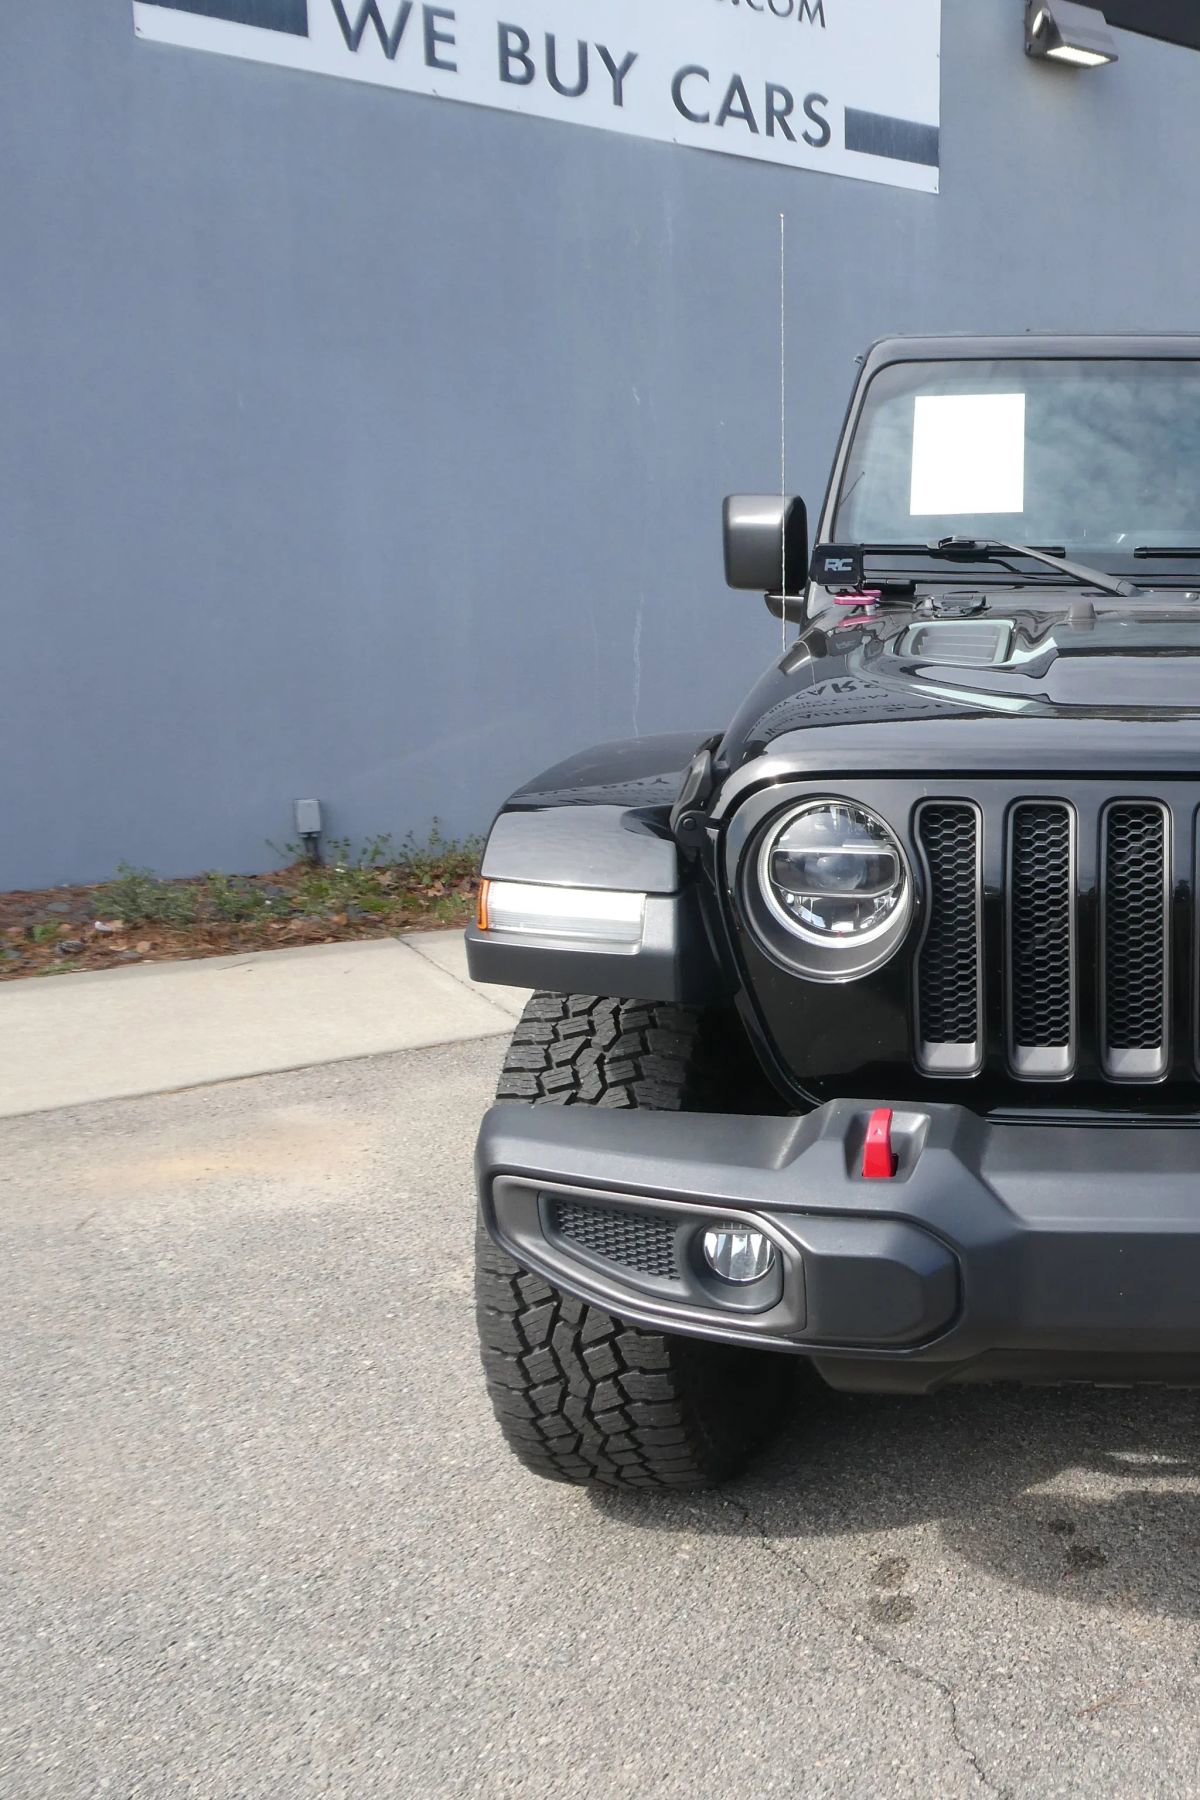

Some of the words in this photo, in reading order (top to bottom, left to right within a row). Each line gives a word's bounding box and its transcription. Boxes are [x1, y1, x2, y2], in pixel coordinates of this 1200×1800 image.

[330, 0, 458, 73] WE
[497, 20, 639, 107] BUY
[671, 63, 832, 148] CARS
[824, 558, 854, 571] RC
